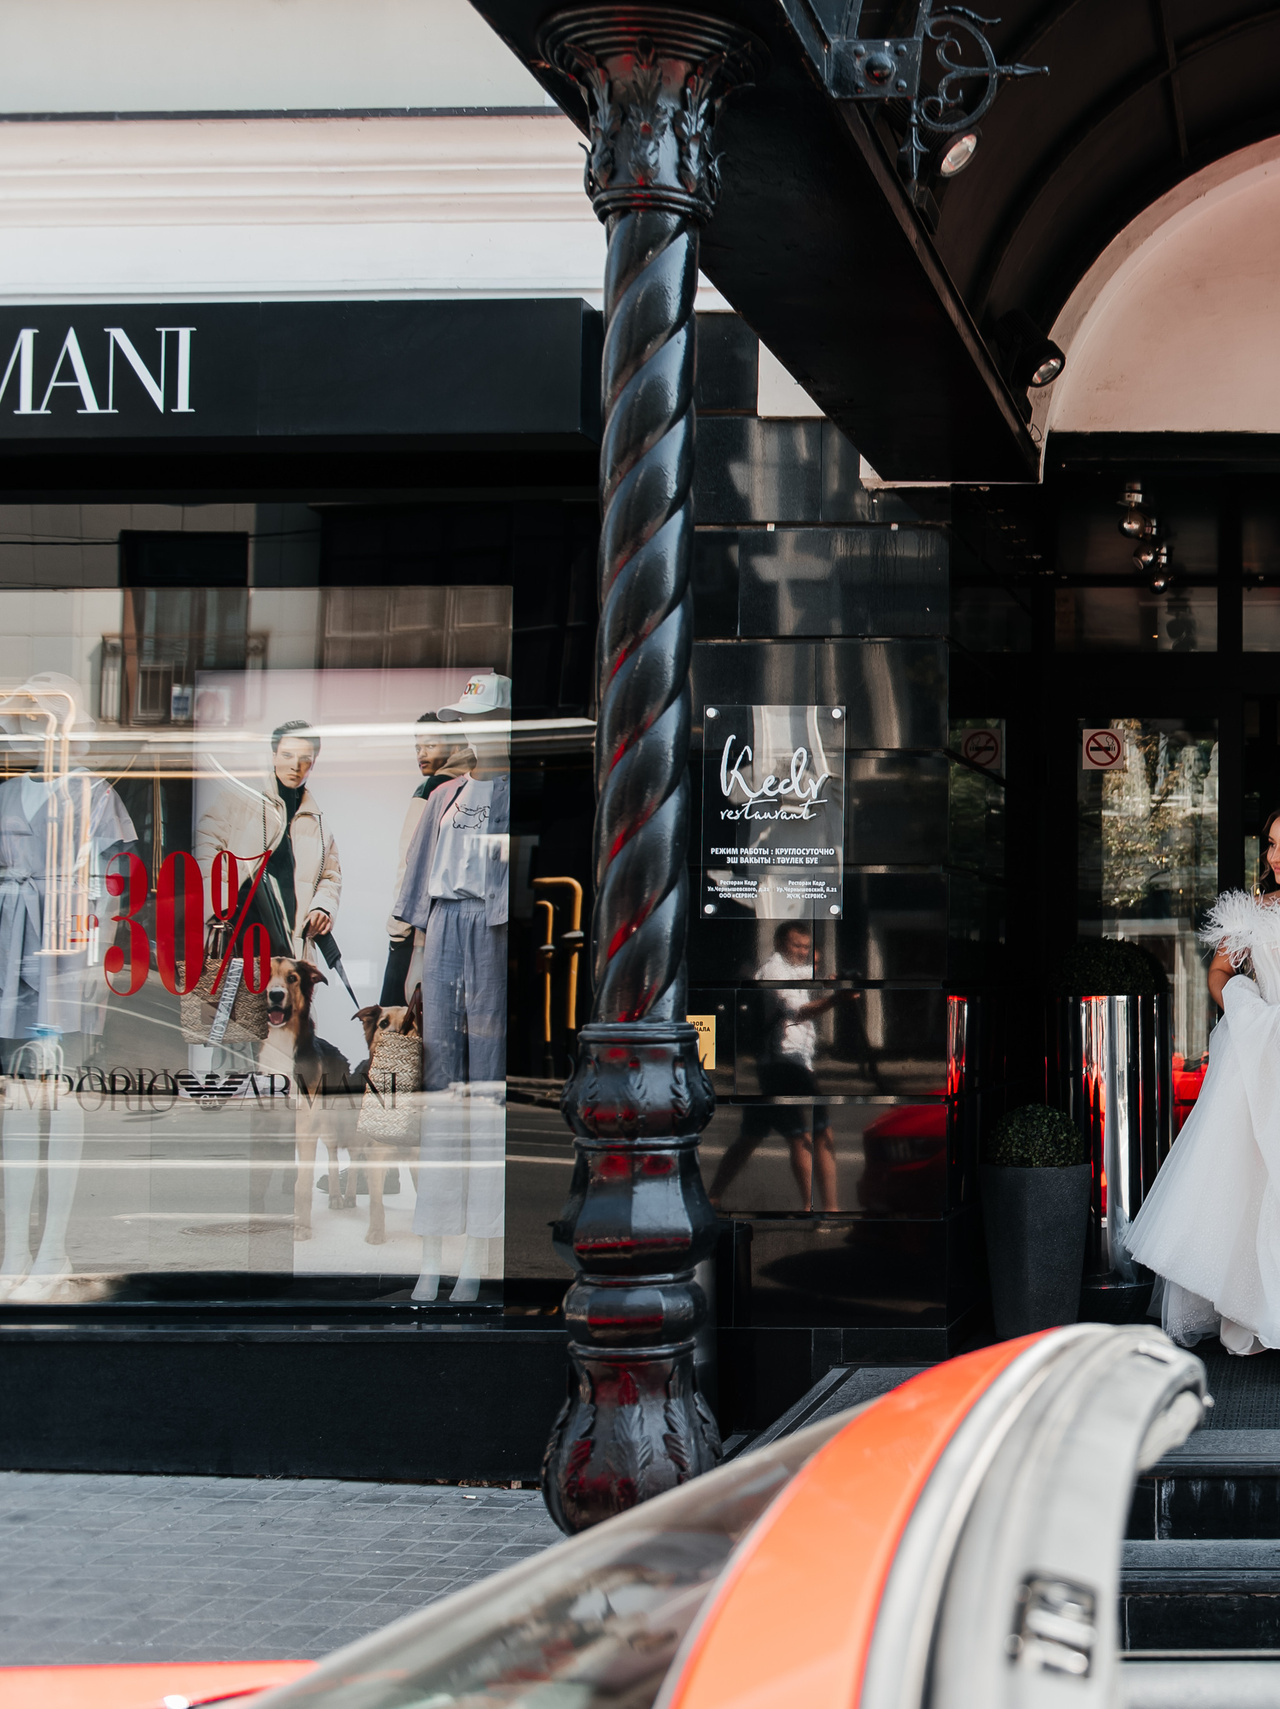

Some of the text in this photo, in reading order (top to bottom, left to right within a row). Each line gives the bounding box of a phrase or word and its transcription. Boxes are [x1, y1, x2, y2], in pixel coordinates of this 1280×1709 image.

[720, 734, 829, 799] Kedr
[720, 797, 828, 820] restaurant
[710, 847, 739, 855] РЕЖИМ
[740, 847, 769, 855] РАБОТЫ
[775, 847, 835, 856] КРУГЛОСУТОЧНО
[726, 856, 739, 864] ЭШ
[740, 856, 771, 864] ВАКЫТЫ
[805, 857, 819, 865] БУЕ
[104, 849, 272, 997] 30%
[237, 1071, 398, 1111] ARMANI
